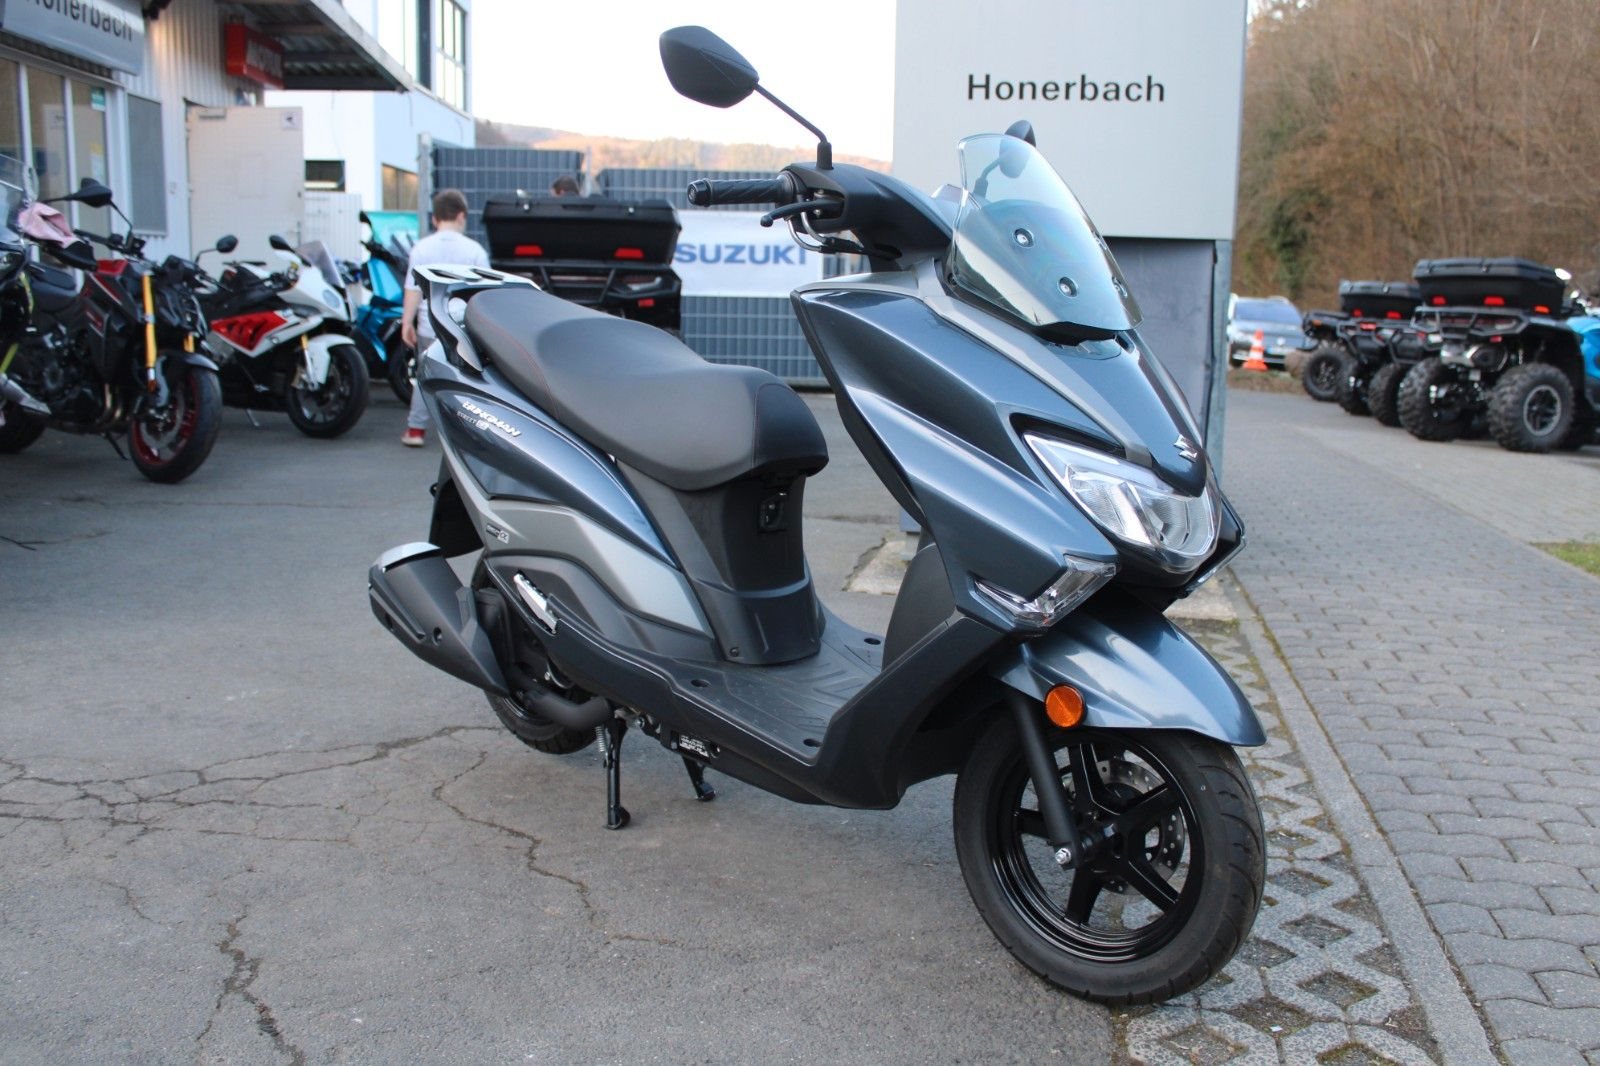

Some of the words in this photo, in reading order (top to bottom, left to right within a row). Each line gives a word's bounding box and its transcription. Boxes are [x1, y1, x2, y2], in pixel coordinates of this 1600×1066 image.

[26, 0, 132, 41] onerbach
[968, 74, 1165, 101] Honerbach
[673, 243, 808, 265] SUZUKI
